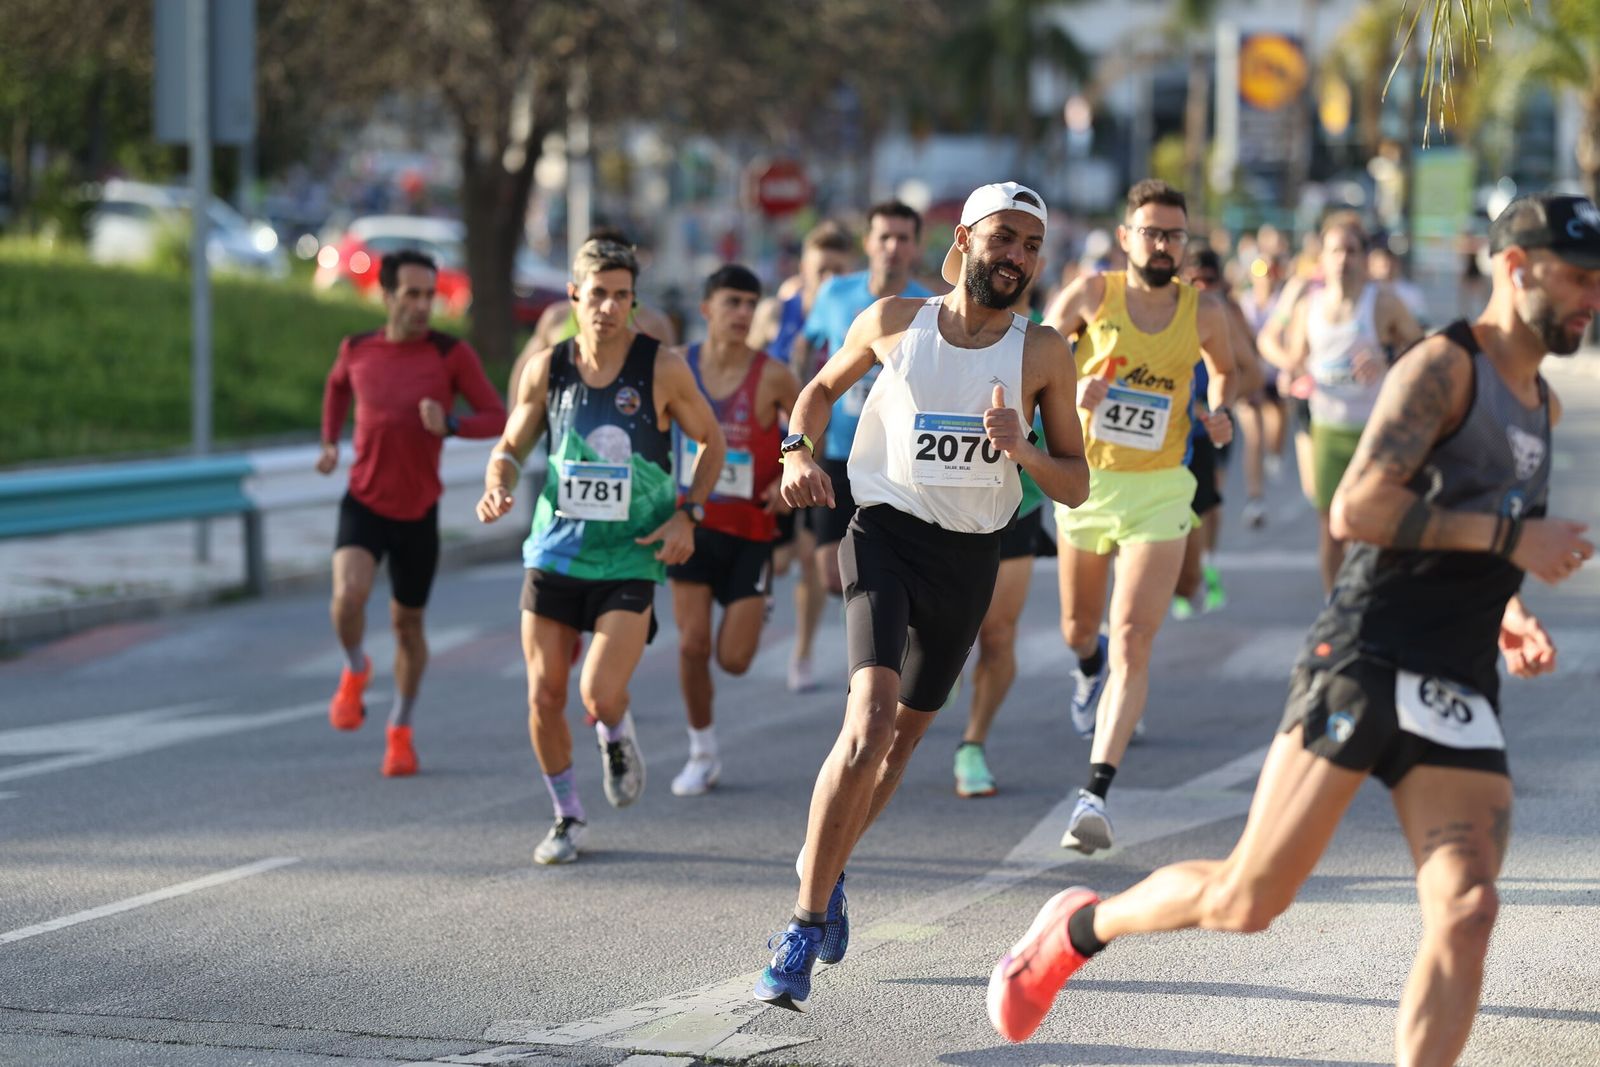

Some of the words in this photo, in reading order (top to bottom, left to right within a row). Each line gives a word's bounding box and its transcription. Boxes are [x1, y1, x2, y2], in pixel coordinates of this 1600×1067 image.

[1105, 403, 1155, 430] 475
[915, 433, 1001, 464] 2070
[564, 479, 622, 502] 1781
